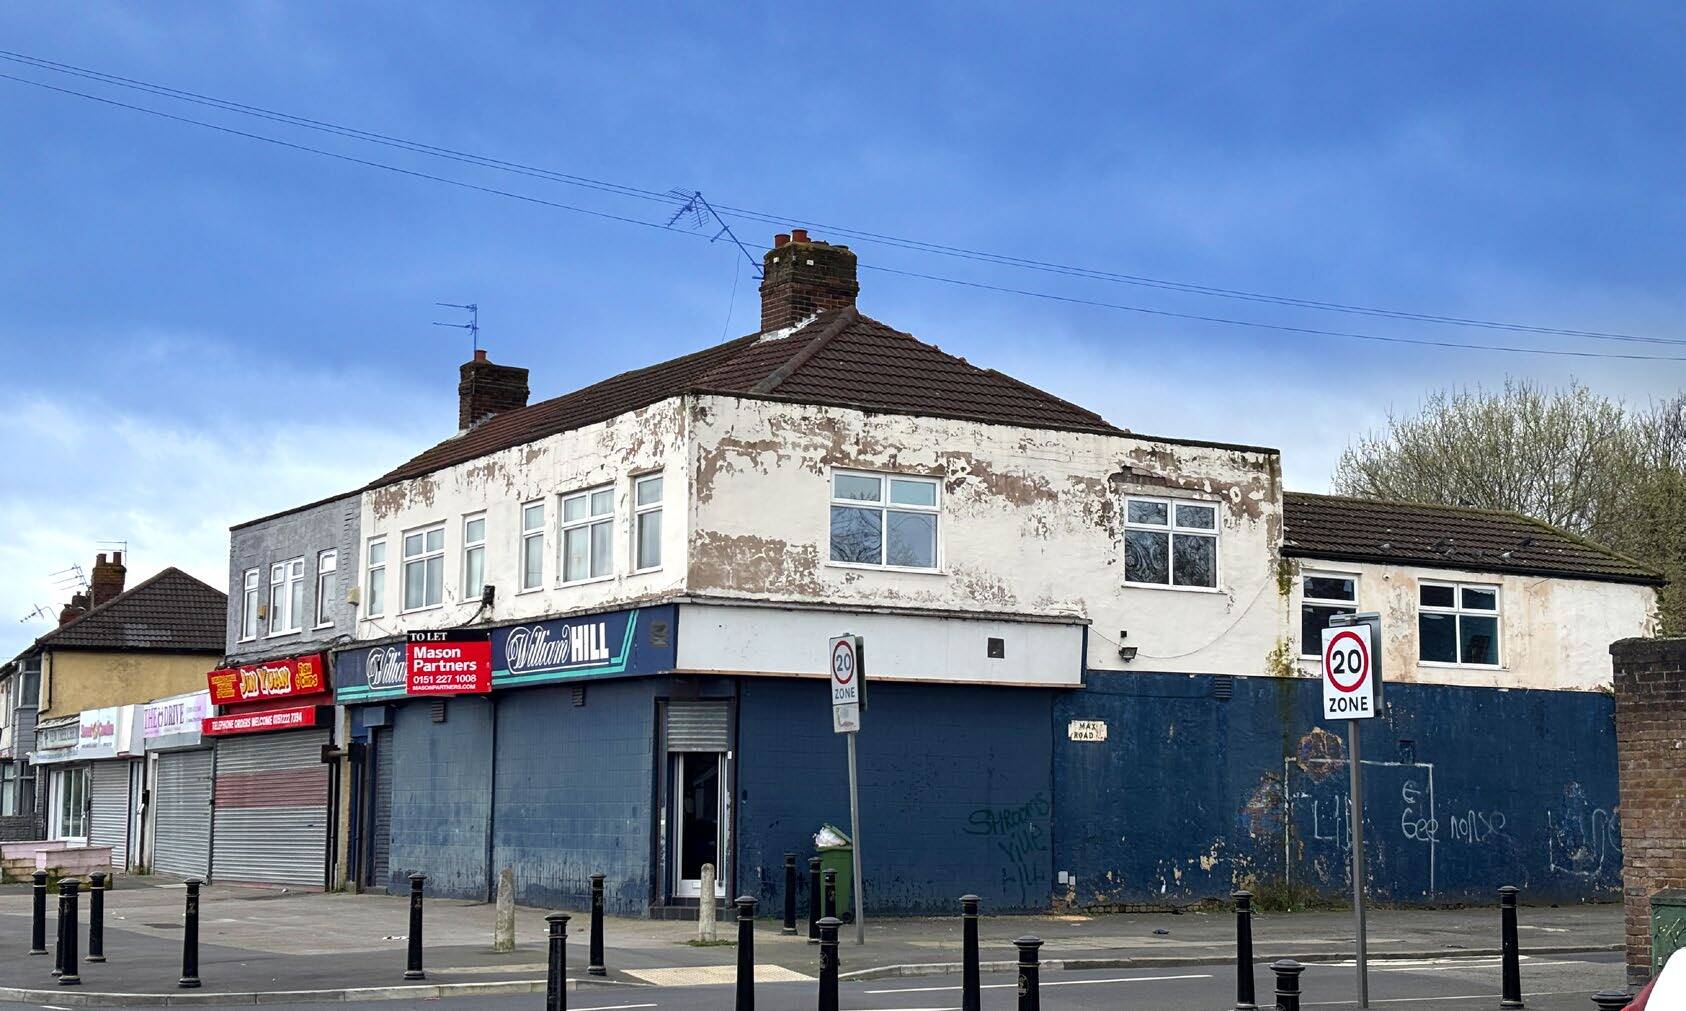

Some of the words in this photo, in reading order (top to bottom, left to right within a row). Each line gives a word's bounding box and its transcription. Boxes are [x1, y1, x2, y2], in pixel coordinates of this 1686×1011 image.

[410, 632, 425, 641] TO
[427, 632, 448, 641] LET
[413, 646, 461, 659] Mason
[505, 624, 571, 670] William
[571, 622, 610, 663] HILL
[413, 660, 477, 672] Partners
[836, 652, 852, 672] 20
[1332, 649, 1362, 674] 20
[413, 675, 433, 684] 0151
[436, 675, 452, 684] 227
[455, 674, 477, 683] 1008
[412, 683, 476, 691] MASONPARTNERS.COM
[835, 686, 855, 700] ZONE
[1329, 696, 1368, 713] ZONE
[212, 719, 234, 731] TELEPHONE
[251, 715, 273, 727] WELCOME
[1079, 722, 1096, 730] MAX
[1073, 731, 1094, 739] ROAD
